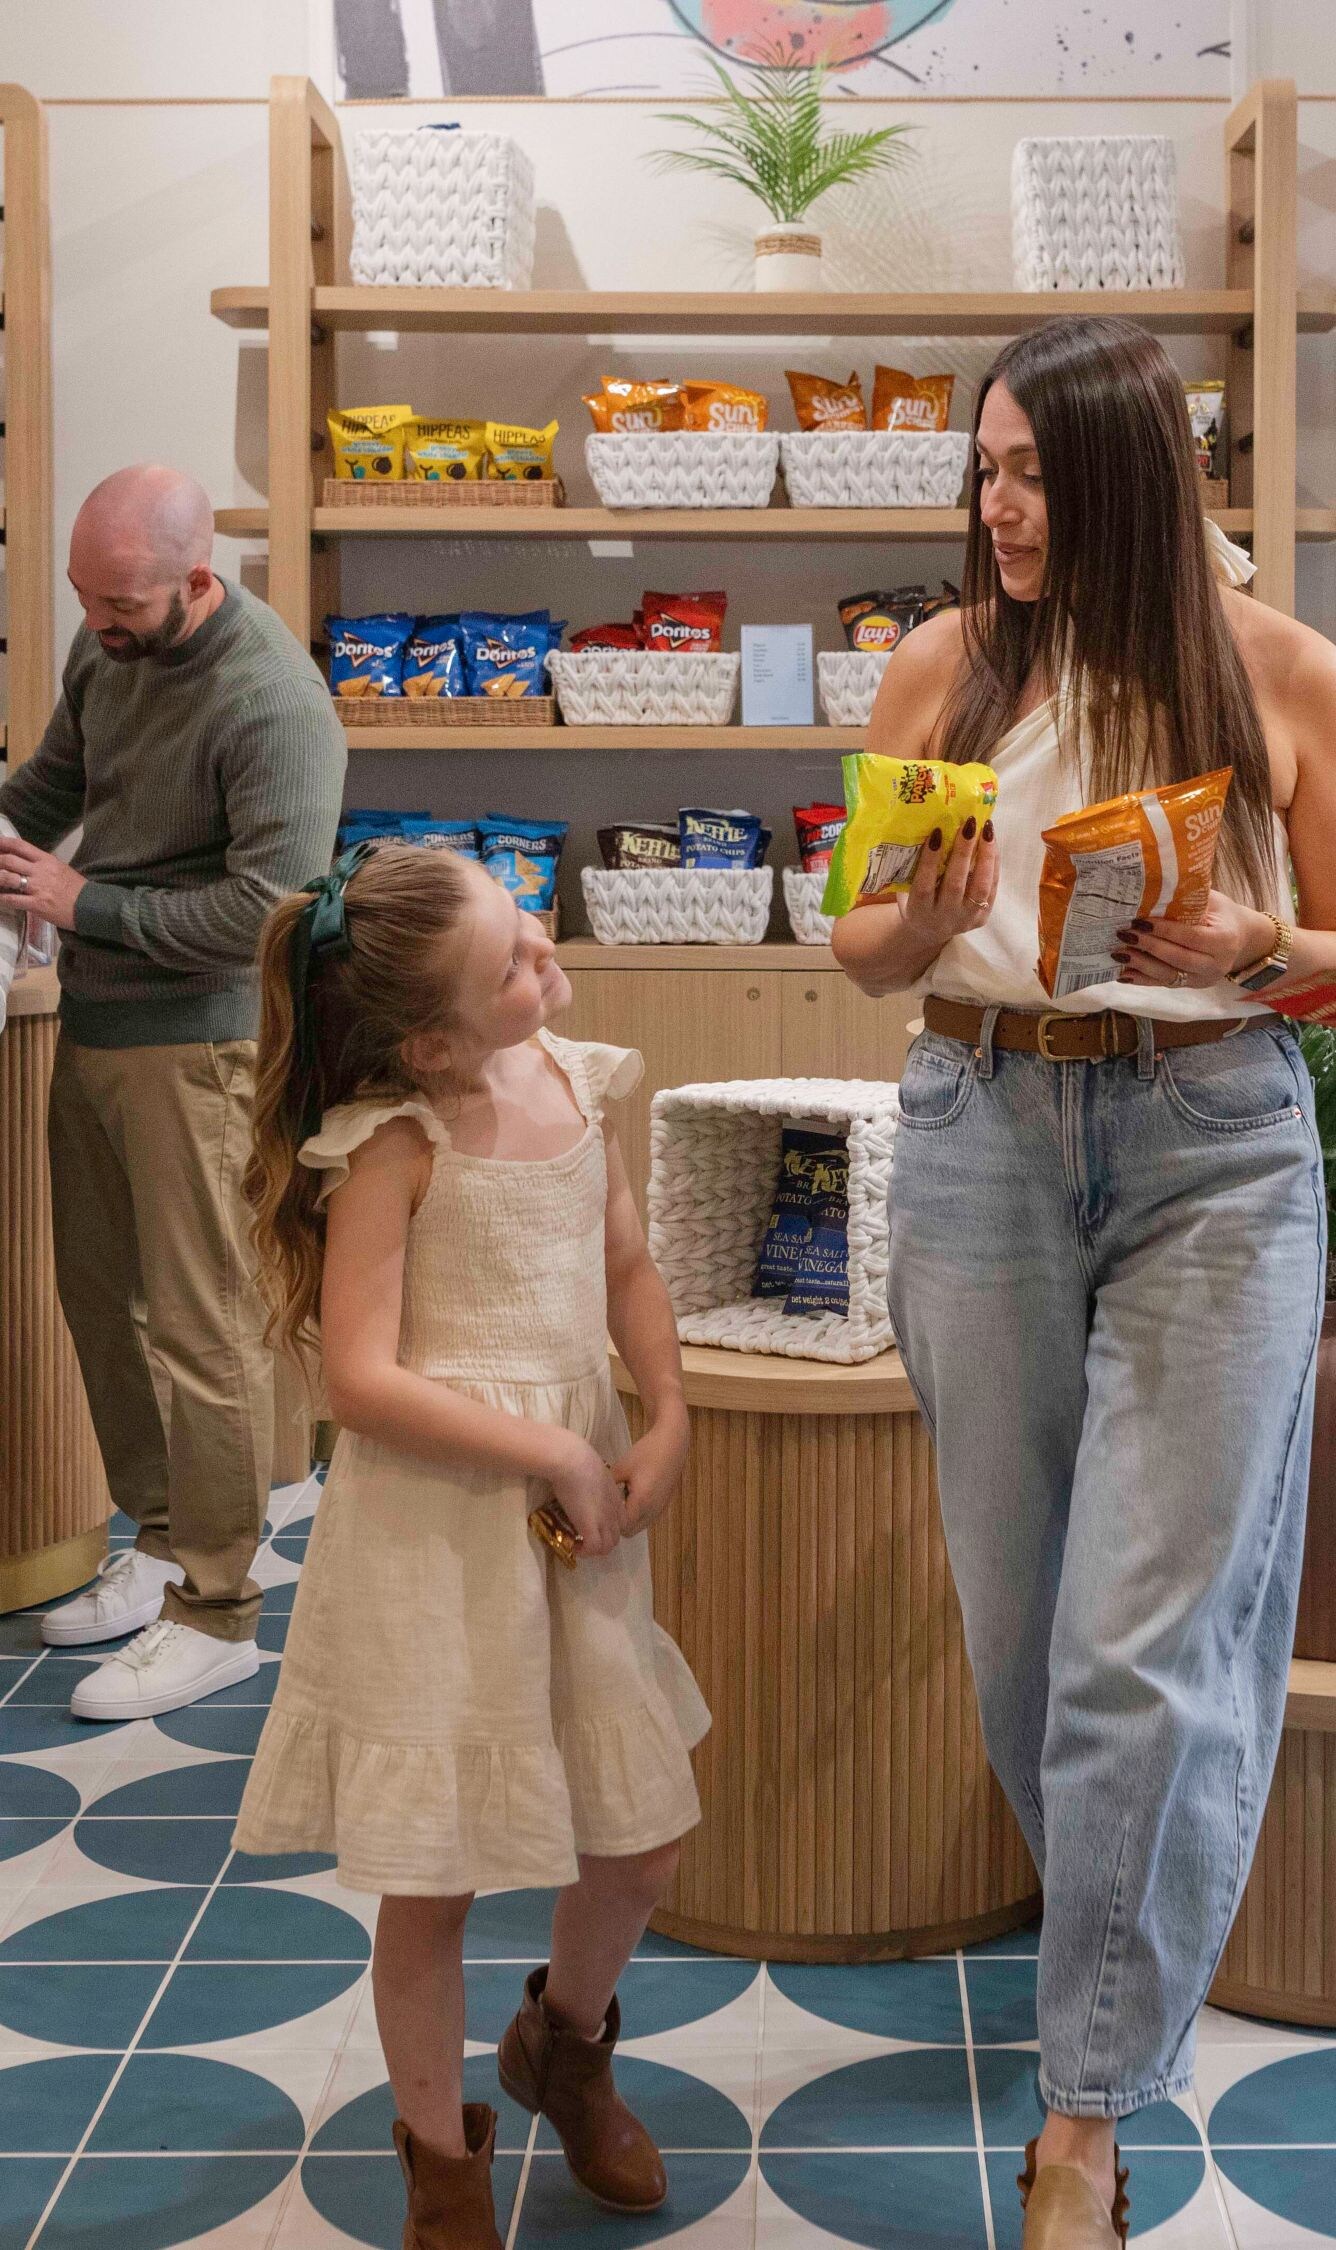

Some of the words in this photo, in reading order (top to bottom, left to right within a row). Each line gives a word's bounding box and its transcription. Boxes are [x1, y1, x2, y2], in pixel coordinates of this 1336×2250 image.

[708, 401, 759, 432] Sun
[887, 396, 940, 426] Sun
[417, 423, 470, 439] HIPPEAS
[651, 623, 711, 640] Doritos
[335, 641, 394, 658] Doritos
[476, 646, 536, 661] Doritos
[899, 763, 920, 804] SOUR
[684, 815, 749, 843] KETTLE
[1184, 803, 1222, 842] Sun
[685, 844, 718, 853] POTATO
[719, 847, 746, 856] CHIPS
[804, 1245, 820, 1257] SEA
